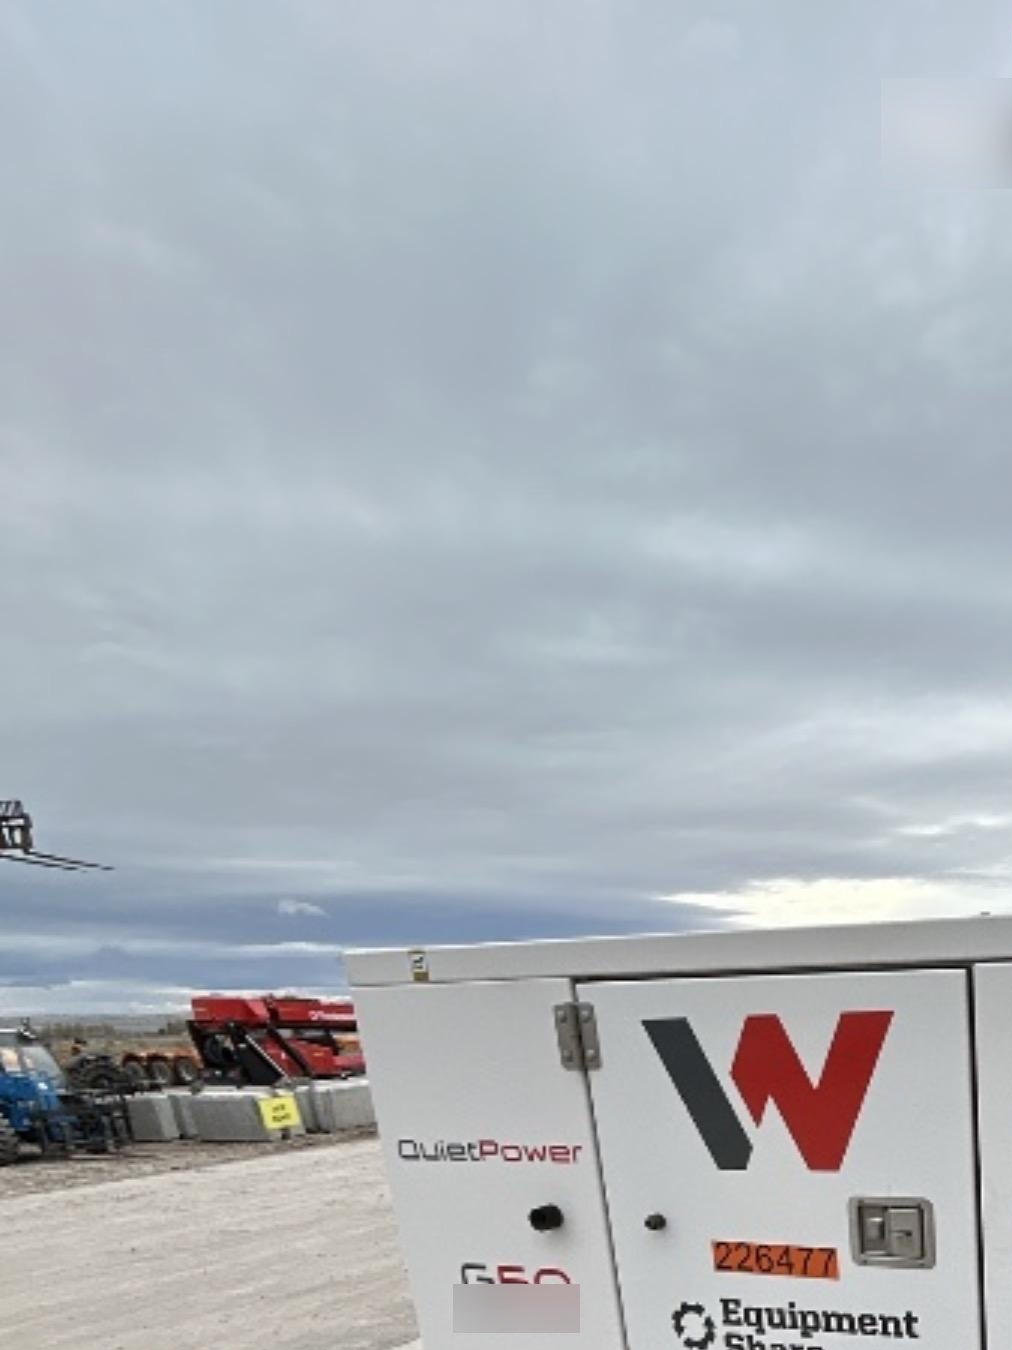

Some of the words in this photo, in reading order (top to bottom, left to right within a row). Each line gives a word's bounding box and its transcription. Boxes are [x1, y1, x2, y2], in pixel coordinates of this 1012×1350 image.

[398, 1139, 583, 1163] QuietPower
[714, 1241, 837, 1277] 226477
[719, 1298, 920, 1339] Equipment
